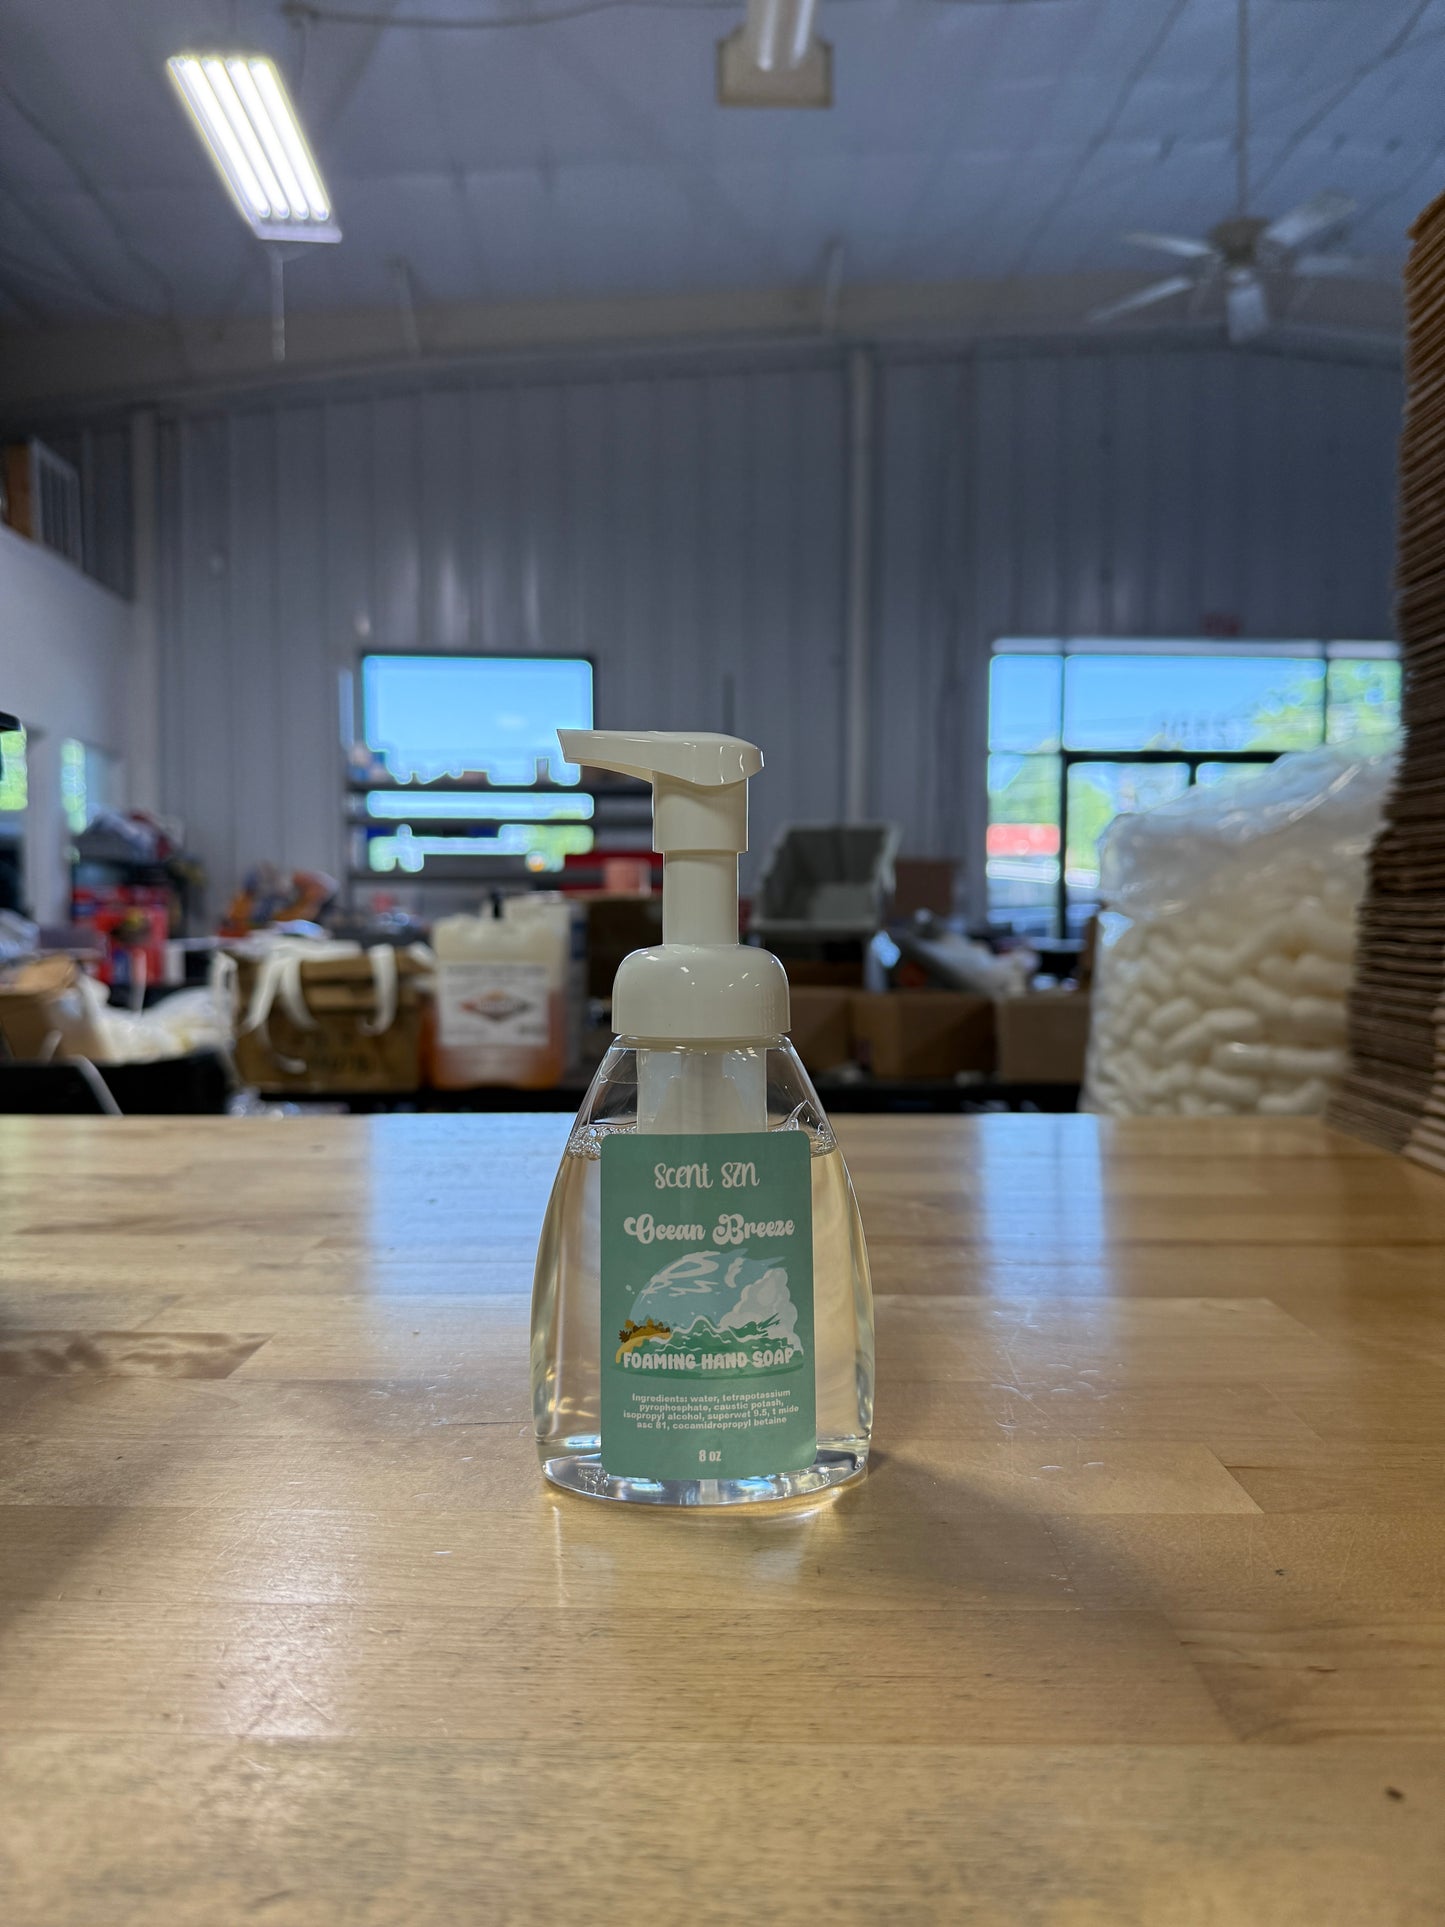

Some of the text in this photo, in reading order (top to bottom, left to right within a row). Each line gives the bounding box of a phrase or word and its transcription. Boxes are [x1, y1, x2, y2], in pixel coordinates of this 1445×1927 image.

[654, 1163, 714, 1189] Scent
[623, 1213, 795, 1245] Ocean Breeze
[623, 1348, 794, 1370] FOAMING HAND SOAP
[632, 1390, 791, 1403] Ingredients: water, tetrapotassium
[640, 1399, 784, 1413] pyrophosphate, caustic potash,
[623, 1410, 665, 1423] isopropyl
[667, 1412, 705, 1421] alcohol,
[753, 1416, 787, 1426] betaine
[699, 1450, 706, 1462] 8
